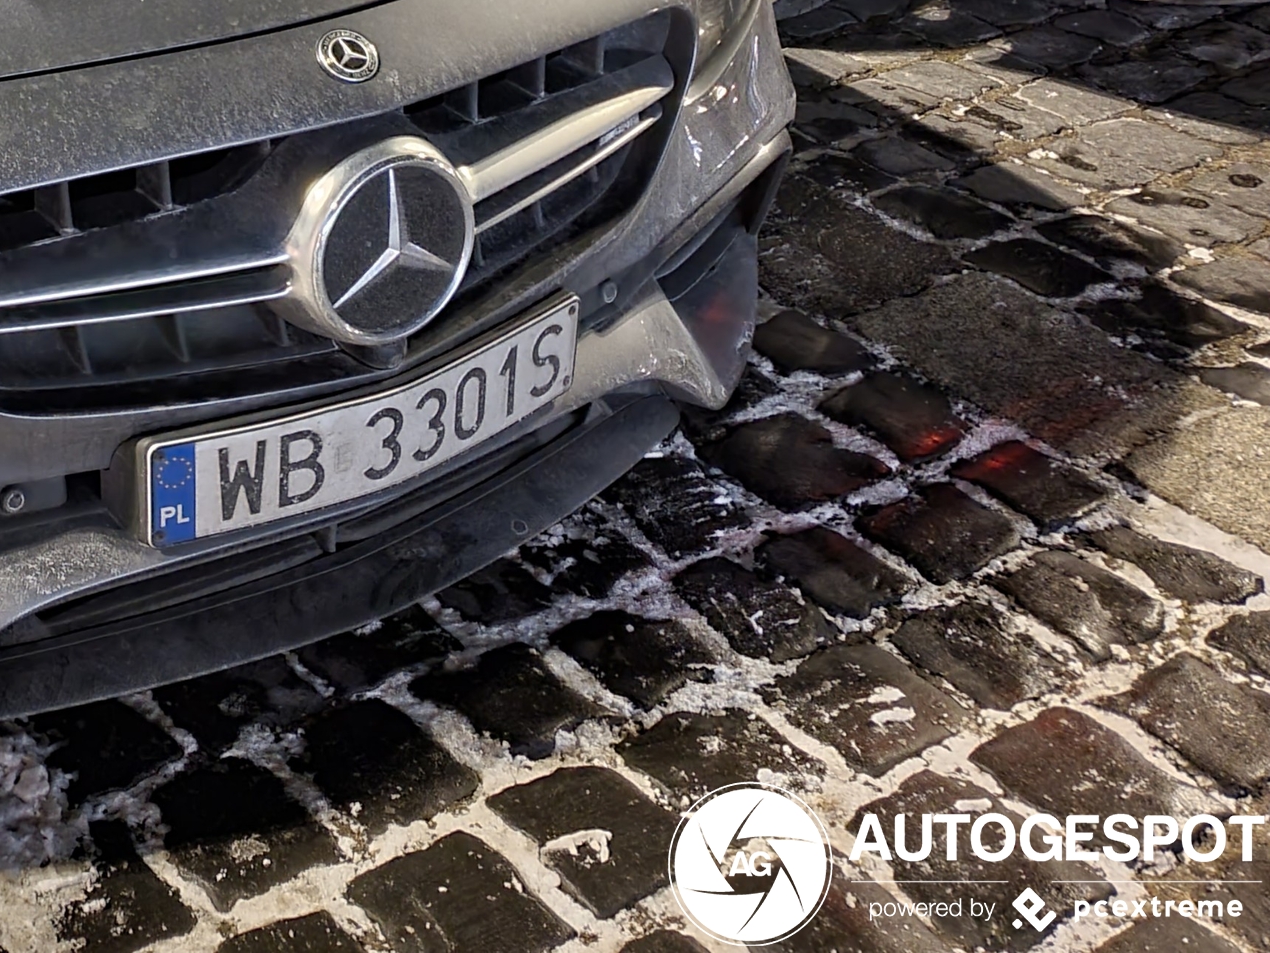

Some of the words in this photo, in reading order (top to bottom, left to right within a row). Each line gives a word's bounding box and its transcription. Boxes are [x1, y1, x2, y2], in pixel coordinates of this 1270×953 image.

[218, 429, 326, 522] WB
[363, 324, 564, 481] 3301S
[160, 503, 190, 528] PL
